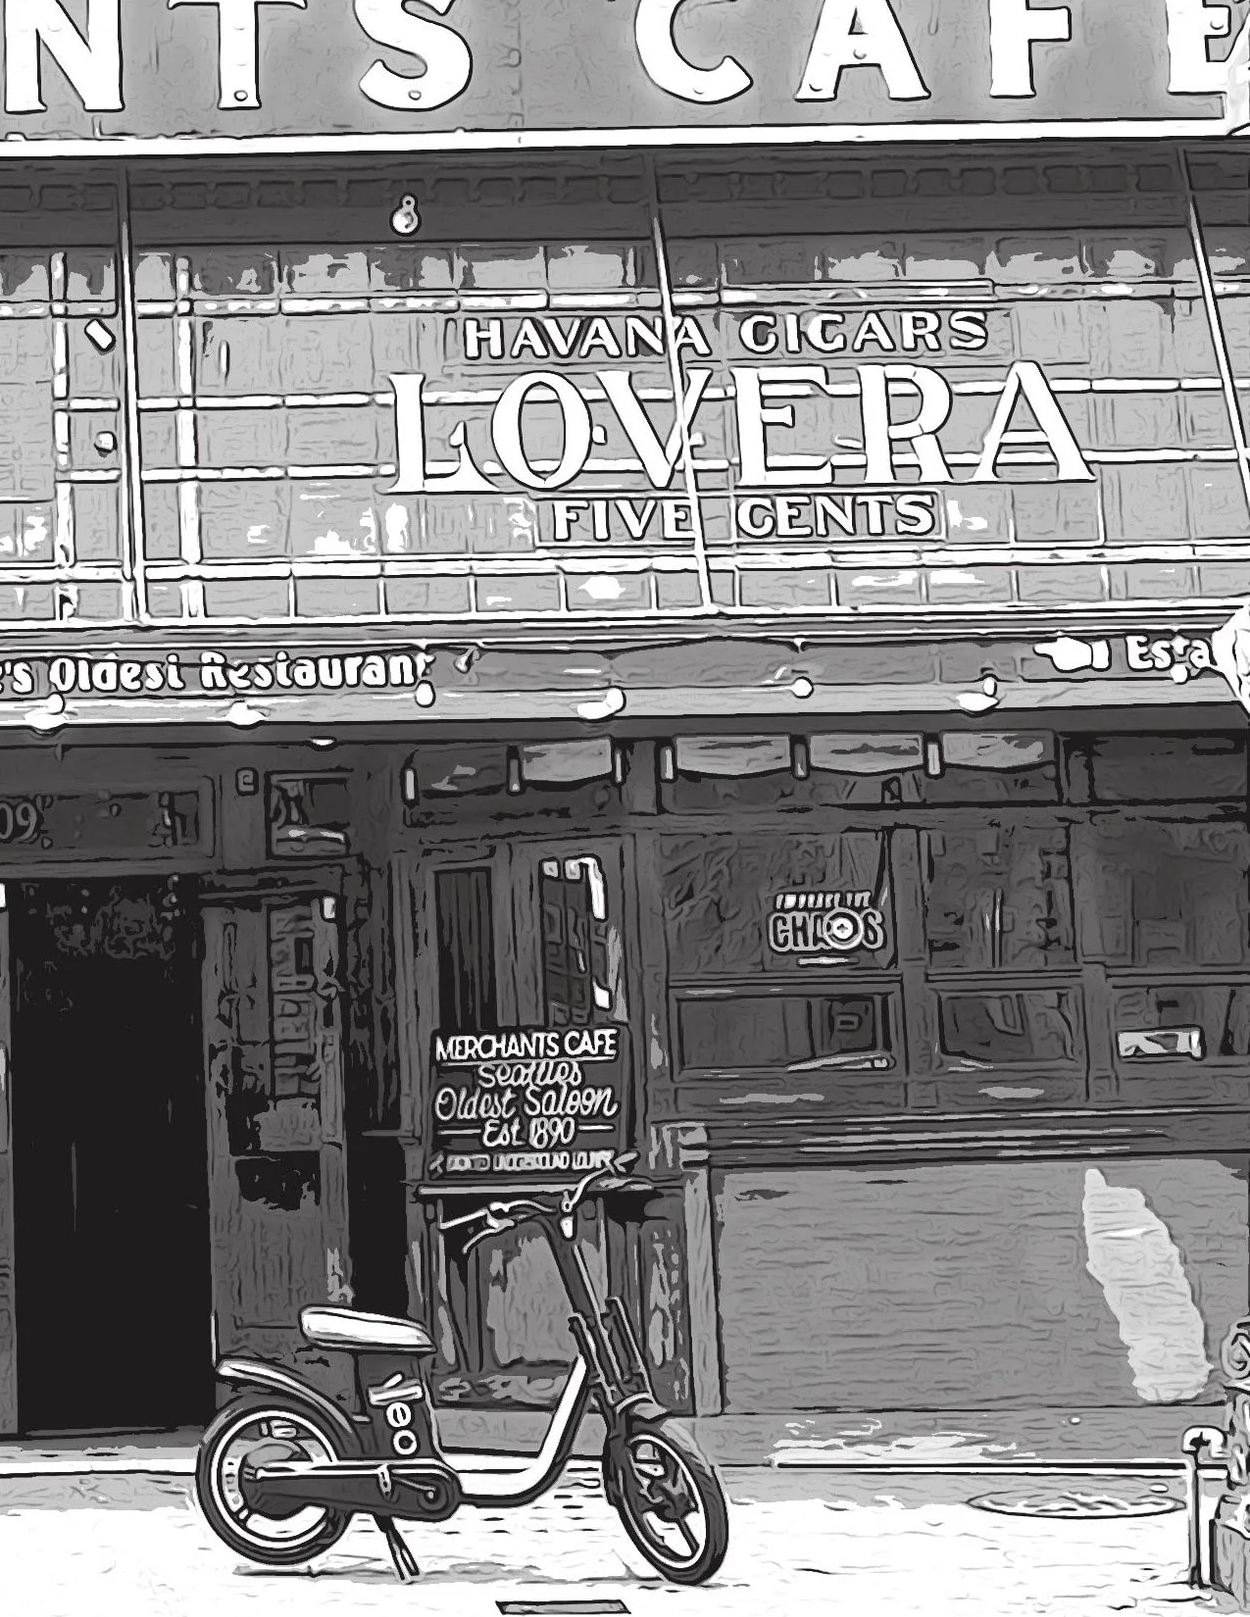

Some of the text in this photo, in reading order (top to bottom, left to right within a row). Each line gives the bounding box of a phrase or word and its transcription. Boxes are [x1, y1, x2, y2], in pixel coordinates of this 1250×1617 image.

[464, 311, 988, 358] HAVANA CIGARS
[386, 361, 1097, 492] LOVERA
[551, 494, 937, 540] FIVE CENTS
[50, 654, 185, 693] Oldest
[435, 1028, 618, 1061] MERCHANTS CAFE
[435, 1082, 619, 1121] Oldest Saloon
[529, 1117, 576, 1149] 1890
